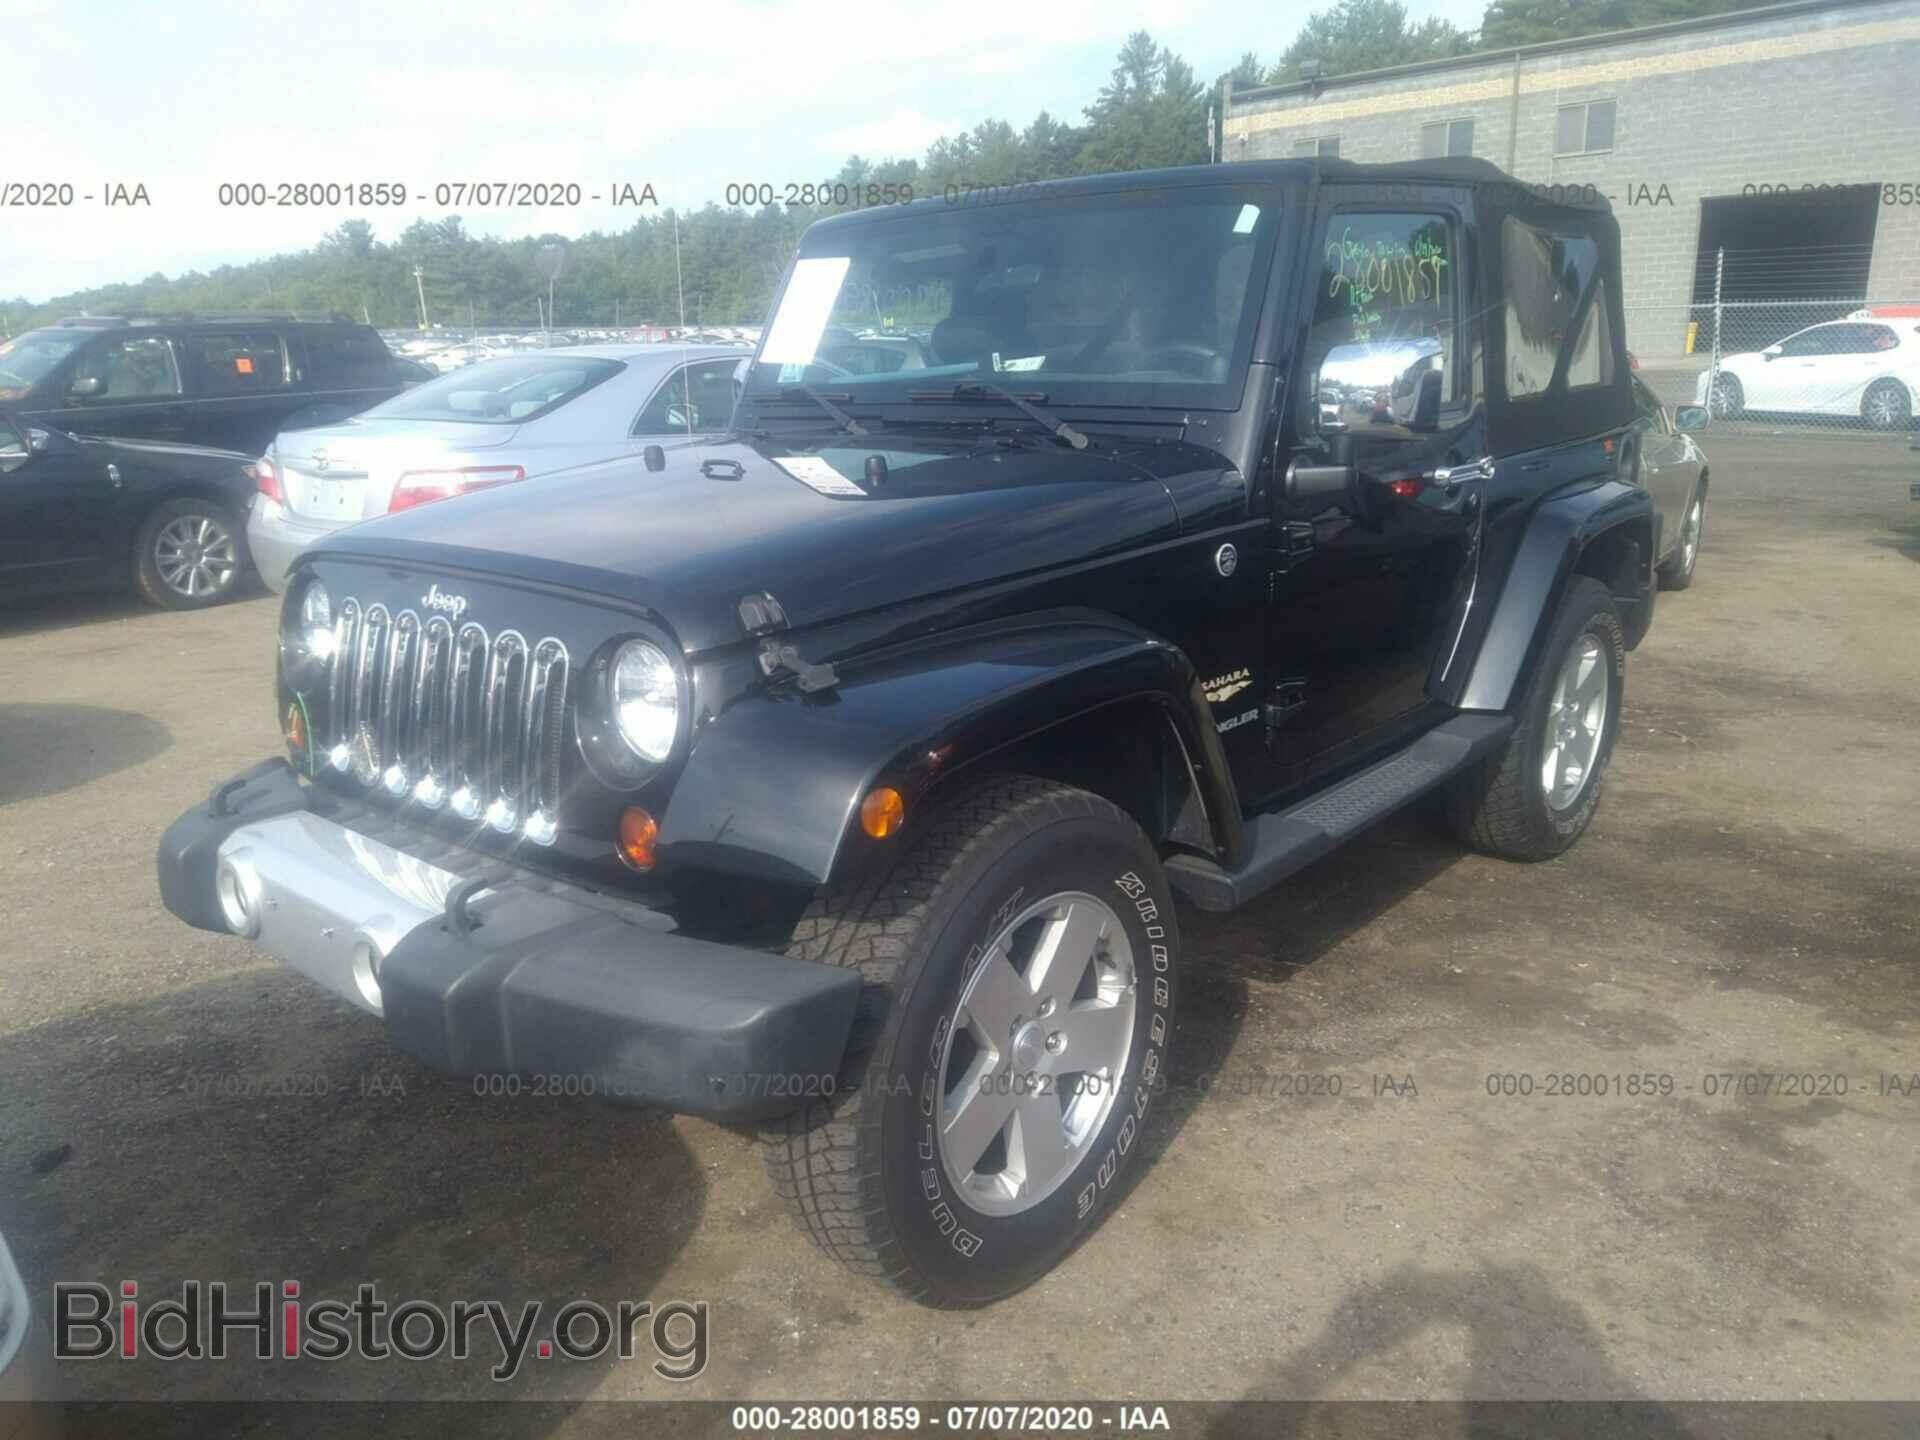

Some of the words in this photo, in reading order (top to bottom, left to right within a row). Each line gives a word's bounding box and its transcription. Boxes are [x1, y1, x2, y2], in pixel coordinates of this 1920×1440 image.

[421, 584, 466, 621] Jeep
[1201, 667, 1250, 691] SAHARA
[1078, 872, 1169, 1219] BRIDGESTONE
[919, 1015, 983, 1257] DUELER
